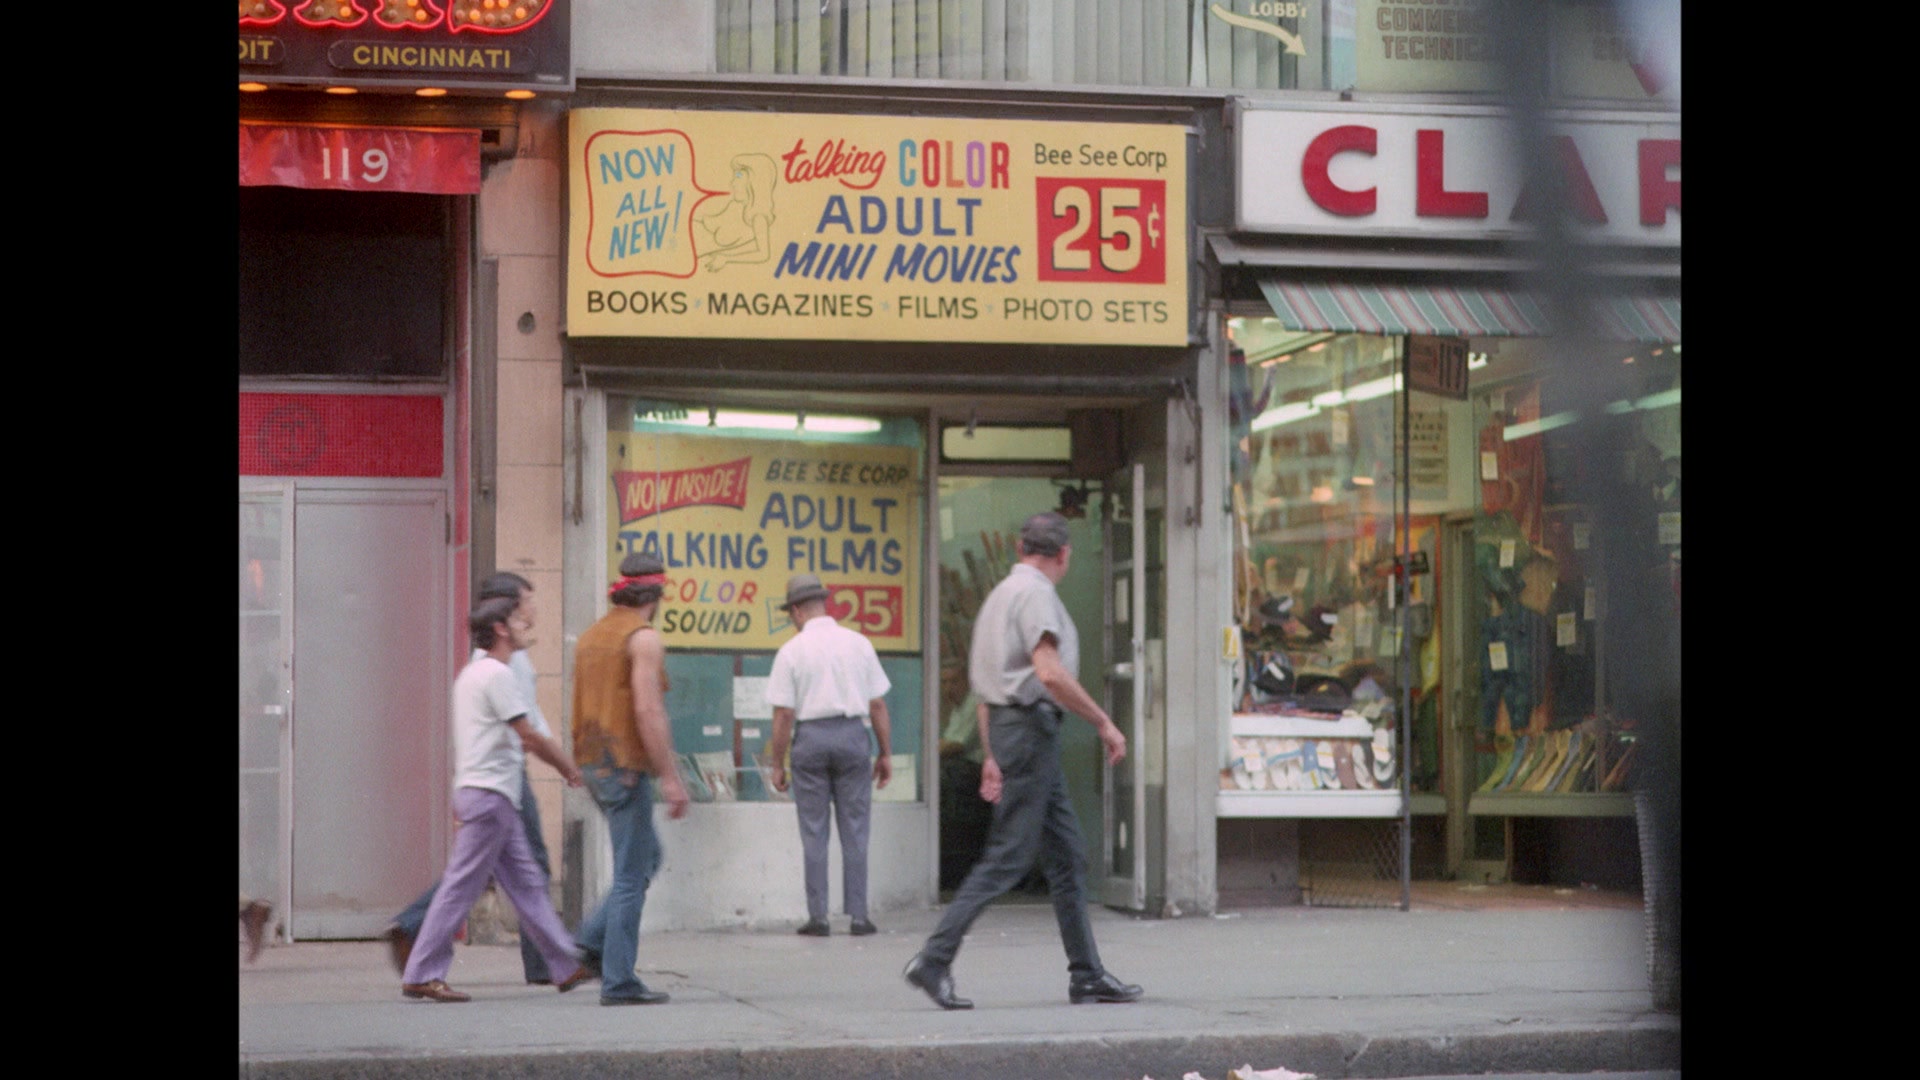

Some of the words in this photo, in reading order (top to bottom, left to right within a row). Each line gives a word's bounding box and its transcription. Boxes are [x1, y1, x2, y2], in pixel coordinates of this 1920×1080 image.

[353, 46, 512, 69] CINCINNATI
[323, 147, 389, 182] 119
[599, 143, 675, 185] NOW
[781, 138, 887, 190] talking
[899, 138, 1010, 189] COLOR
[1035, 143, 1071, 166] Bee
[1079, 145, 1118, 167] See
[615, 185, 667, 219] ALL
[815, 194, 982, 236] ADULT
[608, 190, 683, 261] NEW!
[773, 241, 878, 282] MINI
[884, 243, 1022, 284] MOVIES
[587, 289, 688, 314] BOOKS
[708, 292, 873, 318] MAGAZINES
[899, 296, 978, 320] FILMS
[1004, 298, 1093, 322] PHOTO
[1104, 300, 1169, 323] SETS
[765, 458, 806, 482] BEE
[814, 460, 850, 484] SEE
[859, 462, 909, 486] CORP
[625, 477, 672, 511] NOW
[760, 492, 897, 534] ADULT
[618, 531, 768, 570] TALKING
[788, 537, 903, 575] FILMS
[662, 578, 758, 604] COLOR
[662, 609, 752, 635] SOUND
